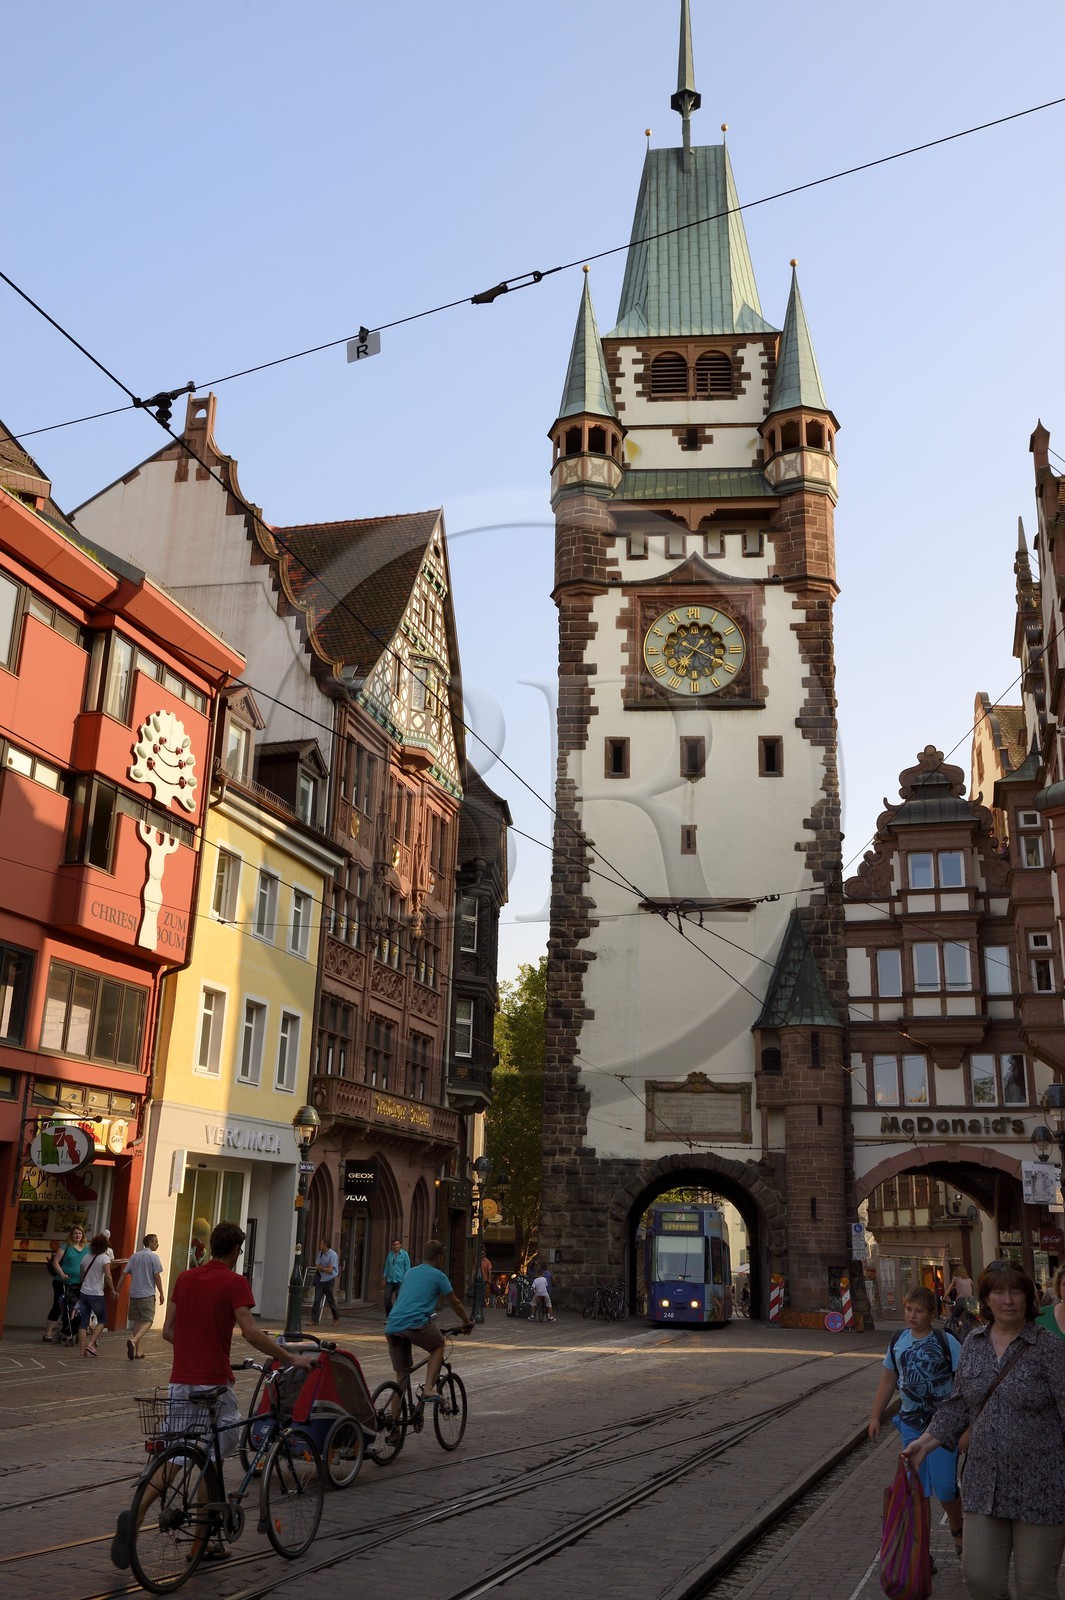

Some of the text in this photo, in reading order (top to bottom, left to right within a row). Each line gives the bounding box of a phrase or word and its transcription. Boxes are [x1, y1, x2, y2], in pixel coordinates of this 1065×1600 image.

[357, 344, 369, 359] R
[91, 901, 138, 932] CHRIESI
[164, 911, 187, 933] ZUM
[880, 1116, 1025, 1134] McDonald's
[204, 1125, 282, 1154] VERO MODA
[678, 1213, 684, 1221] 2
